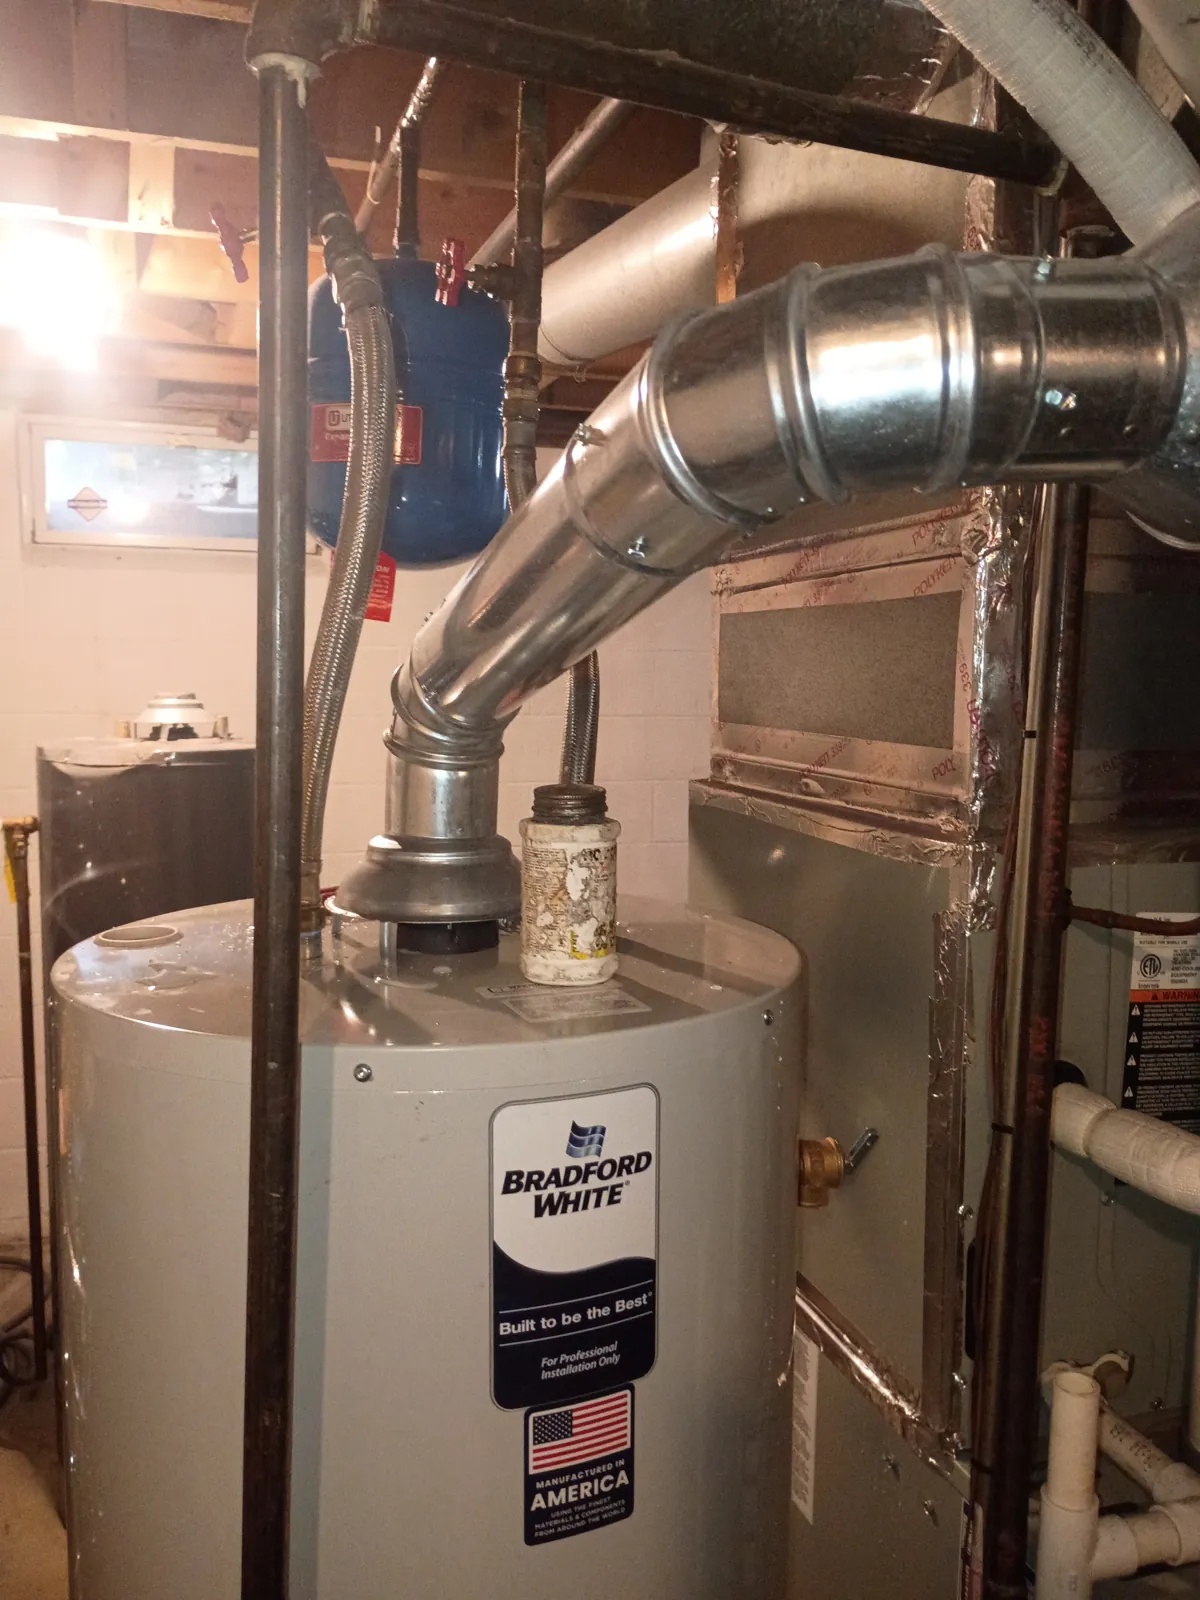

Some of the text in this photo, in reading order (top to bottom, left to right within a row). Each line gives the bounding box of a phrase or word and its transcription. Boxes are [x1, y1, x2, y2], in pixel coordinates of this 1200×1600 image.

[501, 1150, 653, 1195] BRADFORD
[499, 1294, 648, 1336] Built to be the Best
[540, 1341, 618, 1368] For Professional
[540, 1352, 621, 1380] Installation Only
[536, 1458, 626, 1489] MANUFACTURED IN
[530, 1469, 630, 1512] AMERICA
[534, 1516, 574, 1530] MATERIALS
[581, 1498, 626, 1518] COMPONENTS
[534, 1507, 626, 1538] FROM AROUND THE WORLD
[550, 1506, 573, 1518] USING
[574, 1502, 587, 1512] THE
